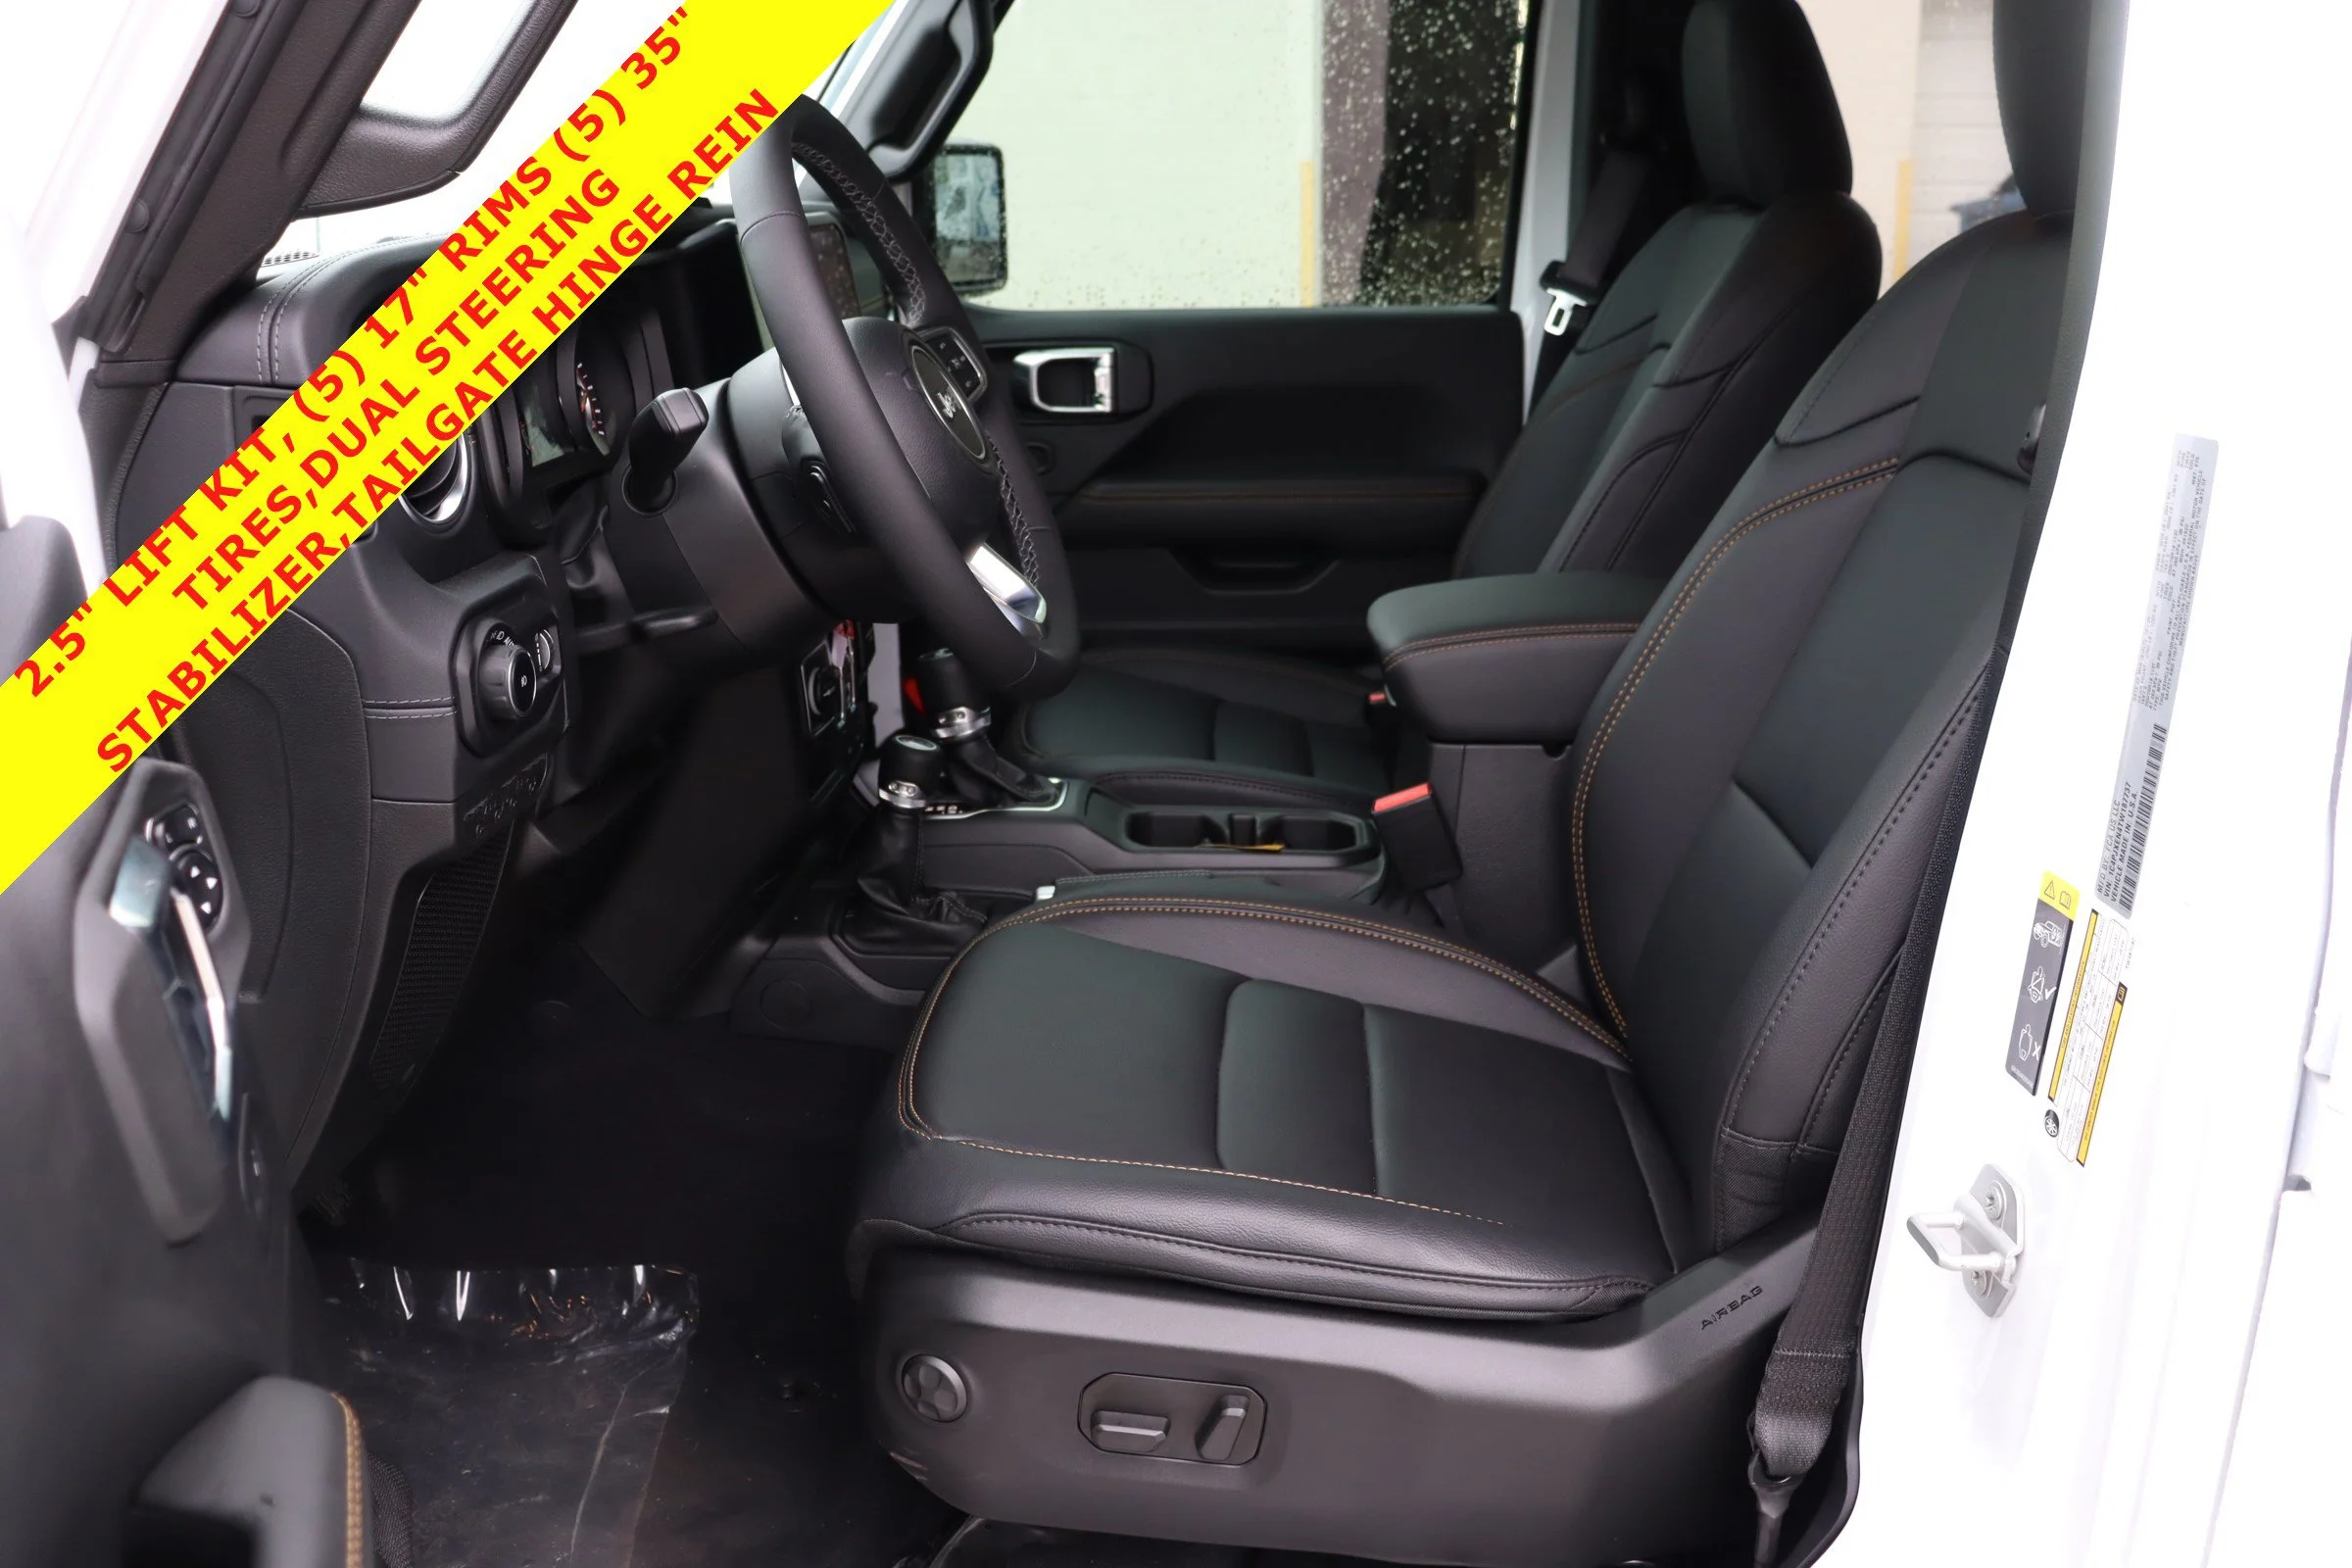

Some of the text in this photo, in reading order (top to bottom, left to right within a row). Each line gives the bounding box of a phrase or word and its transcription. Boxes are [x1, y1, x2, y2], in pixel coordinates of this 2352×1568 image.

[2110, 864, 2123, 903] VEHICLE
[2118, 835, 2129, 862] MADE
[1701, 1285, 1763, 1331] AIRBAG
